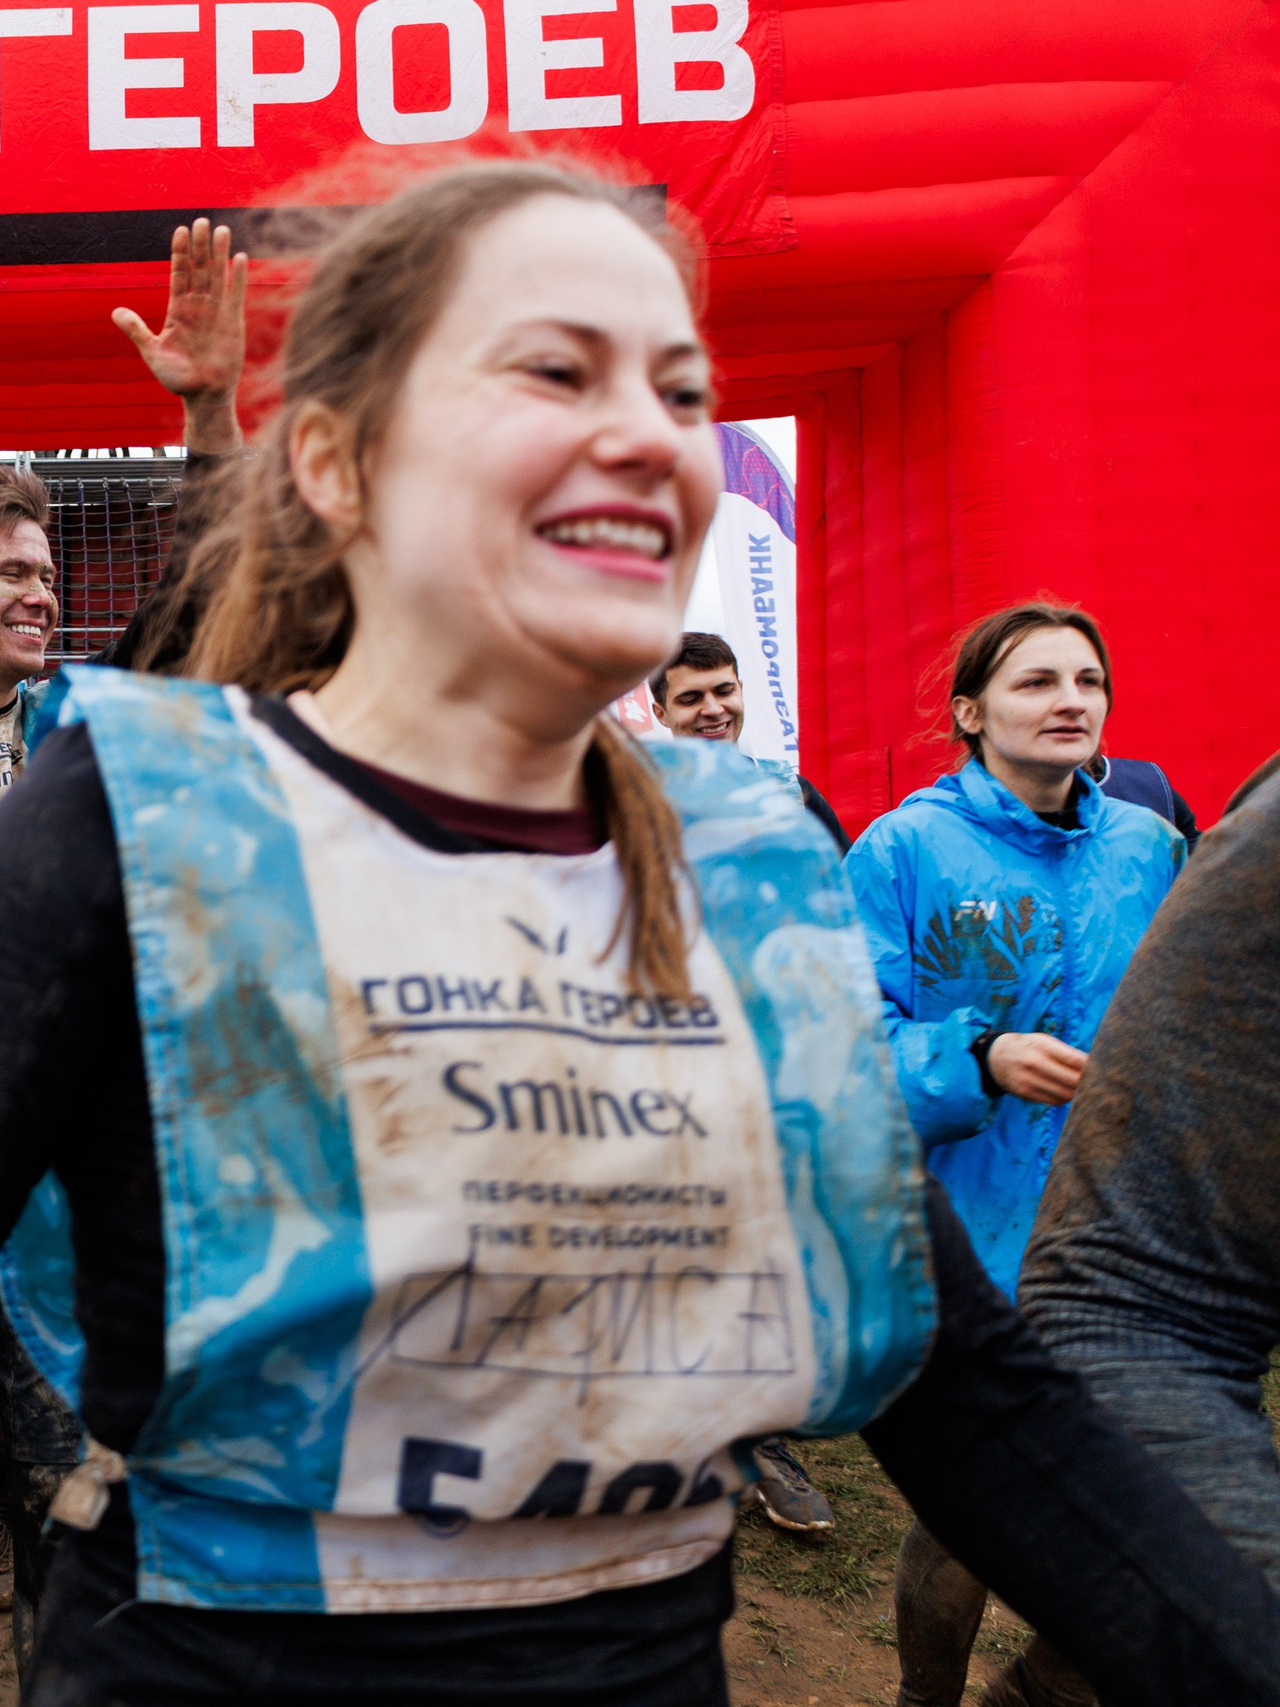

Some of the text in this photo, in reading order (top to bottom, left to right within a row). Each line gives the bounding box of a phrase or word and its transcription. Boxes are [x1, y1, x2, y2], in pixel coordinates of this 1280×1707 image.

[359, 973, 720, 1029] ГОНКА ГЕРОЕВ
[441, 1059, 708, 1142] Sminex
[463, 1180, 726, 1209] ПЕРФЕКЦИОНИСТЫ
[468, 1223, 731, 1249] FINE DEVELOPMENT
